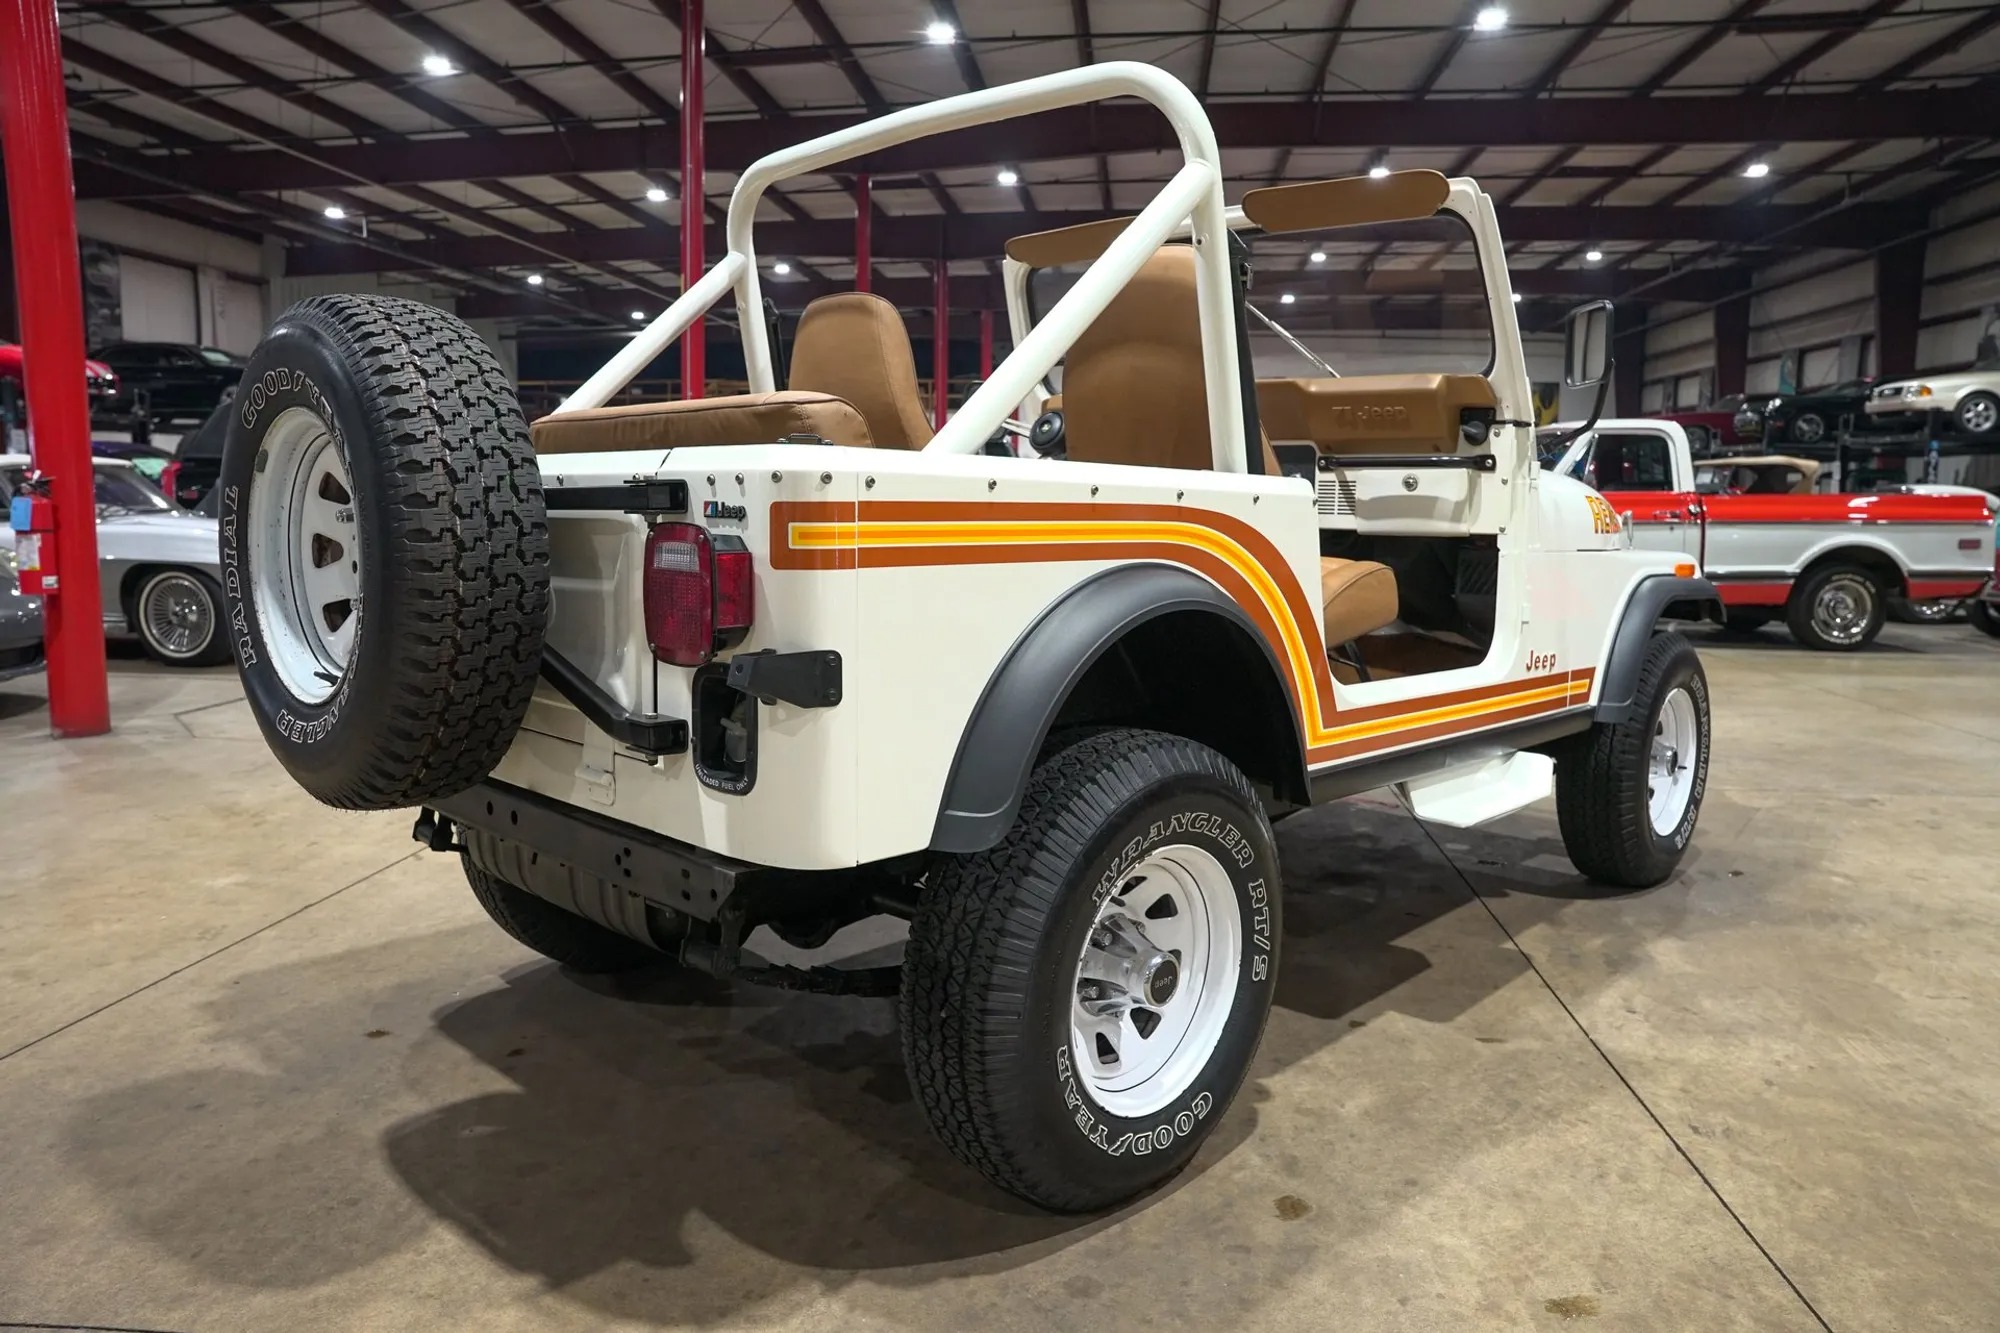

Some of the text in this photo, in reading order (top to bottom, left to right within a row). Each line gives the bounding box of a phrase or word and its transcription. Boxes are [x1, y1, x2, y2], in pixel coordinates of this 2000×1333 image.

[717, 501, 746, 521] Jeep
[223, 485, 257, 669] RADIAL
[276, 592, 364, 743] ANGLER
[1526, 650, 1556, 672] Jeep
[695, 763, 719, 787] UNLEADED
[735, 775, 748, 790] ONLY
[1092, 811, 1271, 982] WRANGLER RT/S
[1056, 1045, 1214, 1156] GOODYEAR
